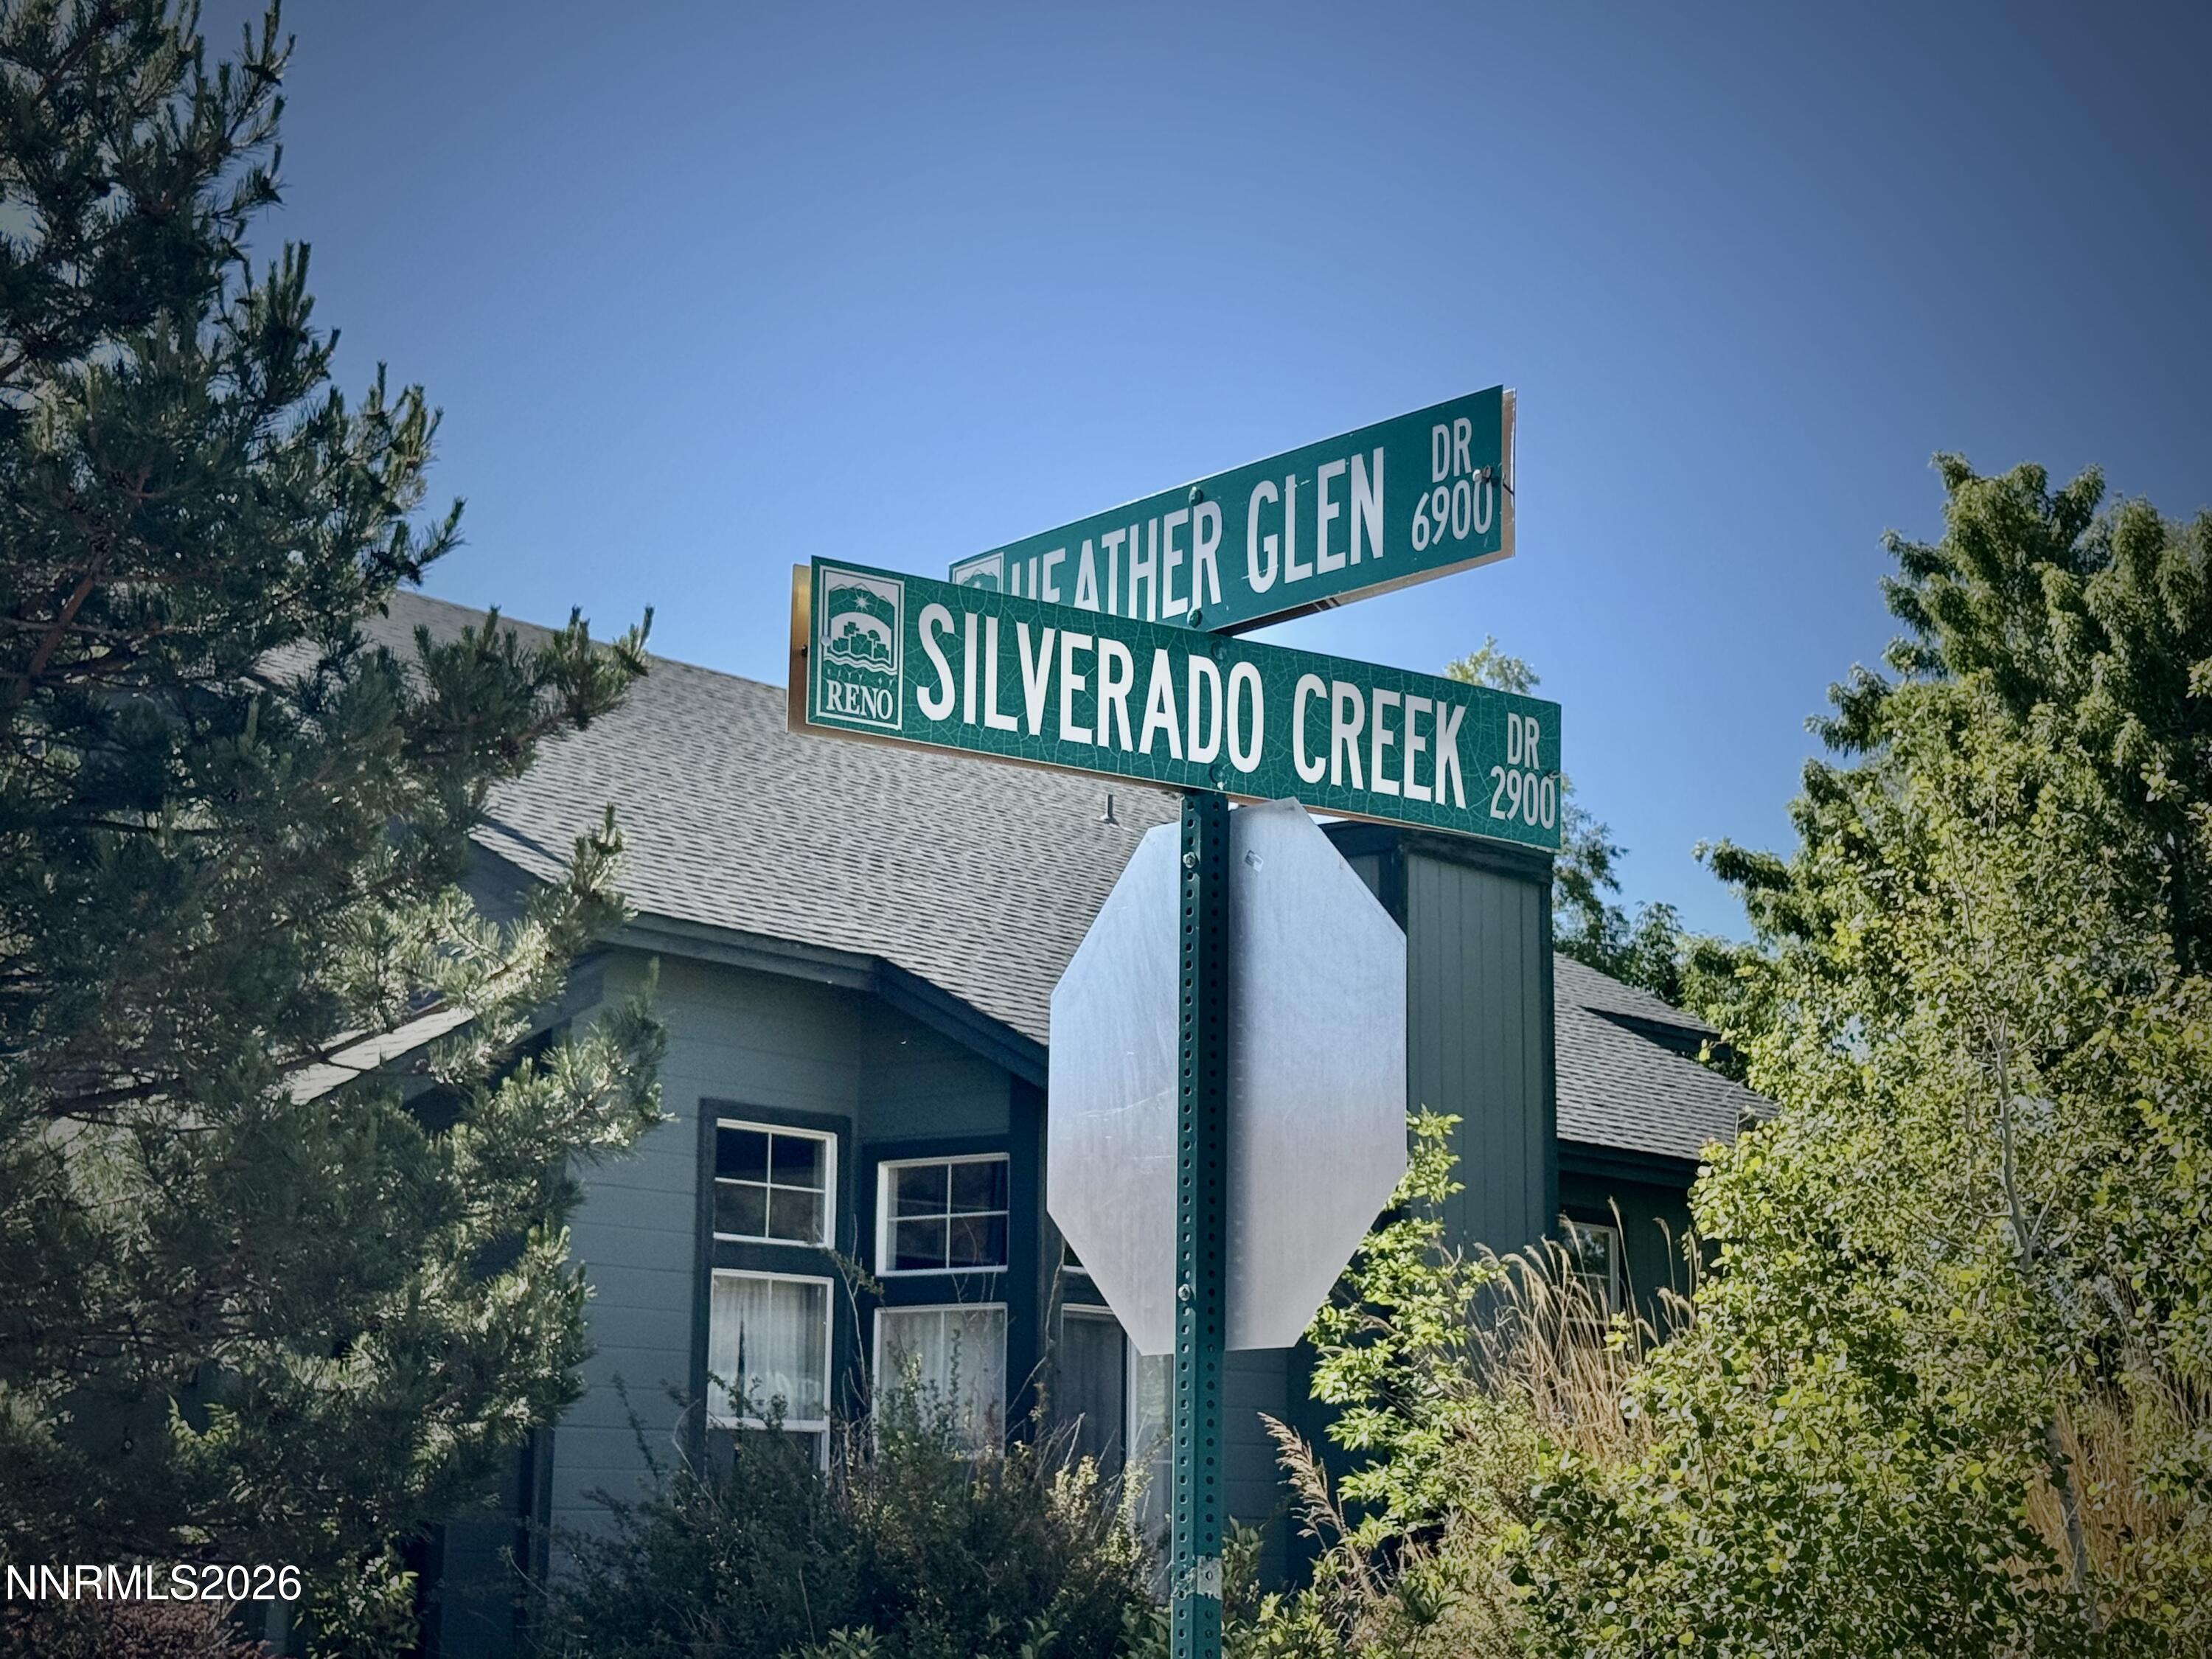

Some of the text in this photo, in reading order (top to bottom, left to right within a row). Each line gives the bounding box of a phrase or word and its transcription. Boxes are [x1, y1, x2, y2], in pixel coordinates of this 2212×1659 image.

[1431, 417, 1472, 484] DR
[1247, 446, 1385, 594] GLEN
[1411, 479, 1494, 552] 6900
[825, 678, 894, 720] RENO
[917, 603, 1467, 810] SILVERADO CREEK
[1506, 712, 1540, 771] DR
[1489, 765, 1557, 830] 2900
